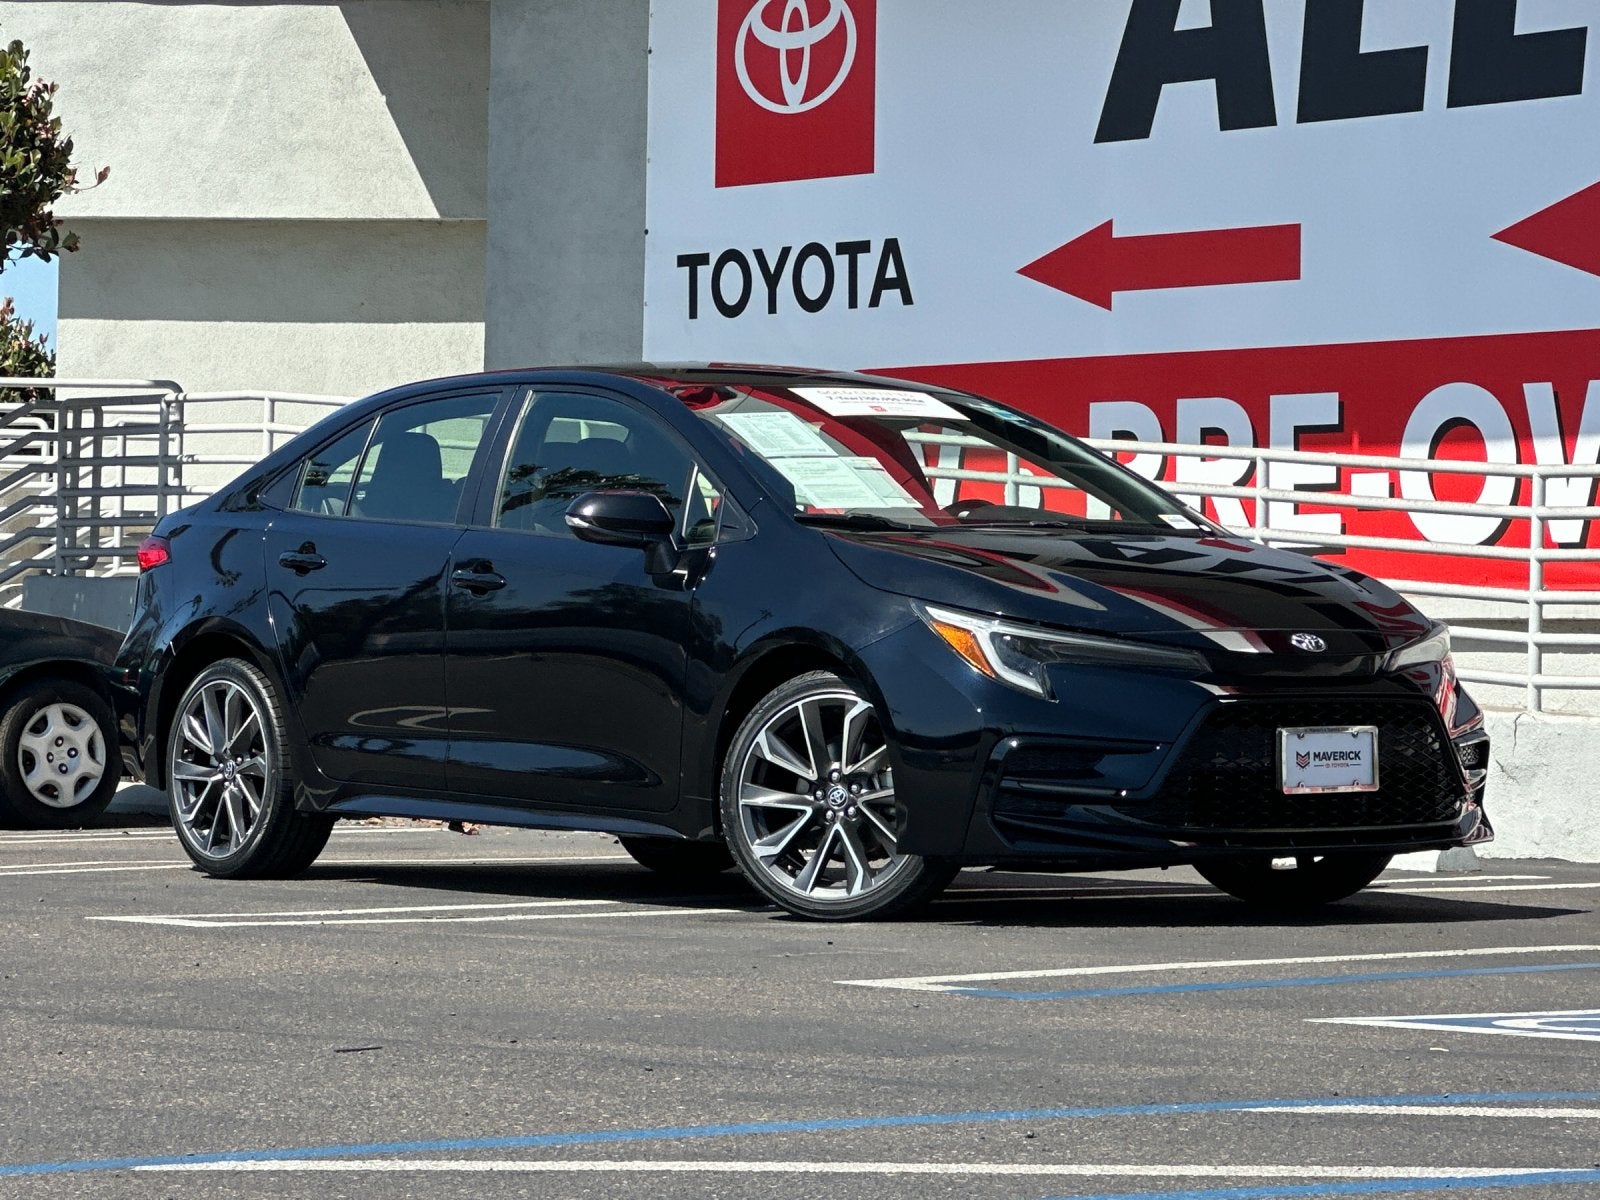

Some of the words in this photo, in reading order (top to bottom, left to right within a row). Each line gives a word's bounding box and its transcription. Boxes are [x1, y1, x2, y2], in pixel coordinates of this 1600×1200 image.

[1093, 0, 1588, 144] ALL
[676, 237, 914, 320] TOYOTA
[1313, 750, 1362, 762] MAVERICK
